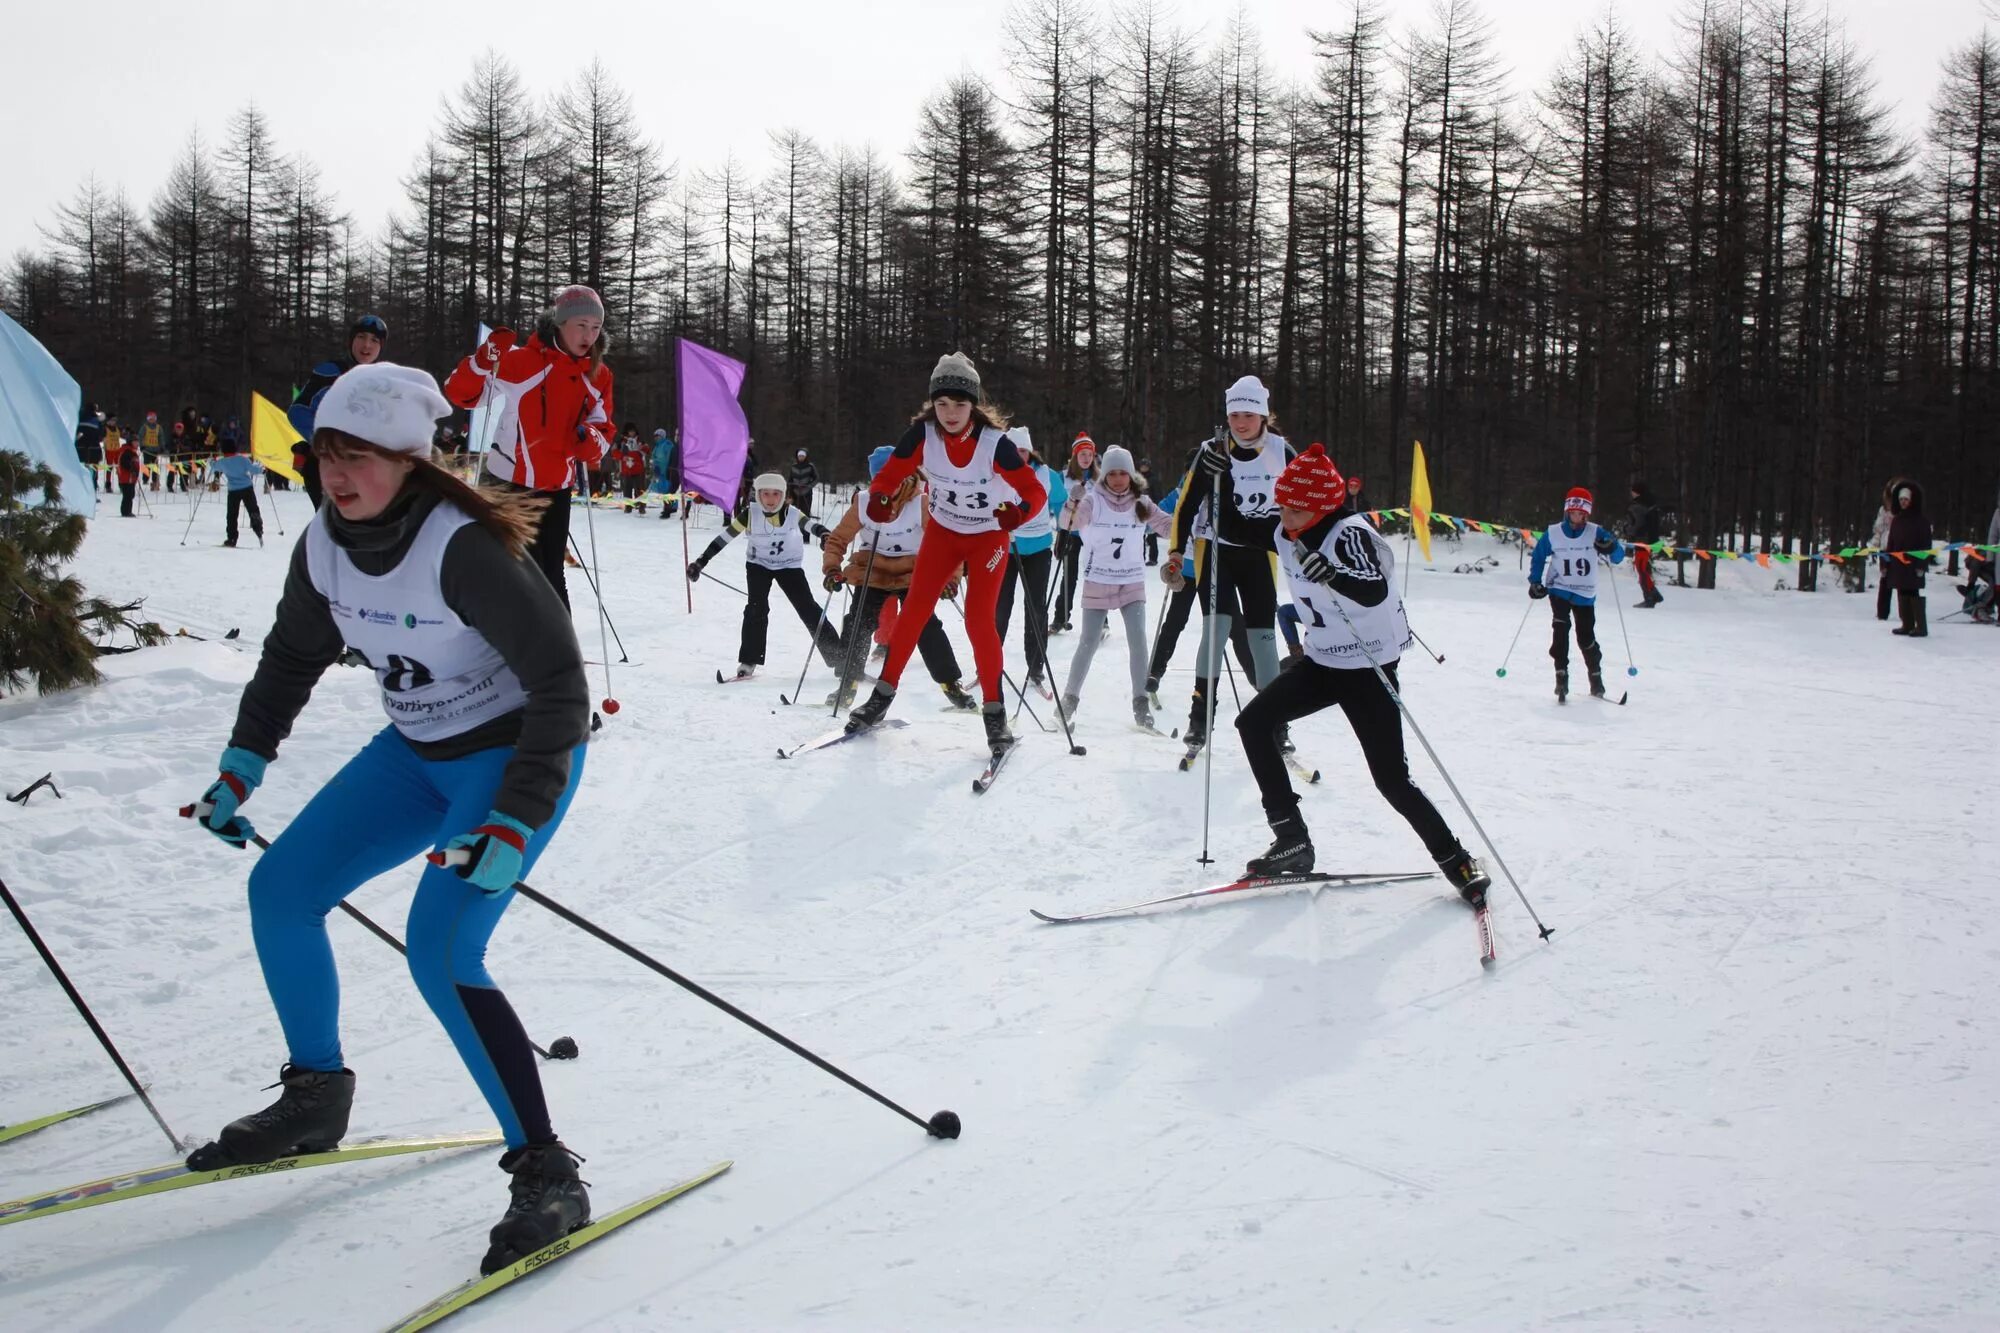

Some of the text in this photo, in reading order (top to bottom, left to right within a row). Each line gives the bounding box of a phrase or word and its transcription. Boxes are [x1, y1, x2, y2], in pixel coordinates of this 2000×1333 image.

[1111, 537, 1125, 560] 7
[1563, 558, 1591, 577] 19
[1270, 842, 1307, 861] SALOMON
[230, 1160, 299, 1178] FISCHER
[525, 1240, 570, 1271] FISCHER
